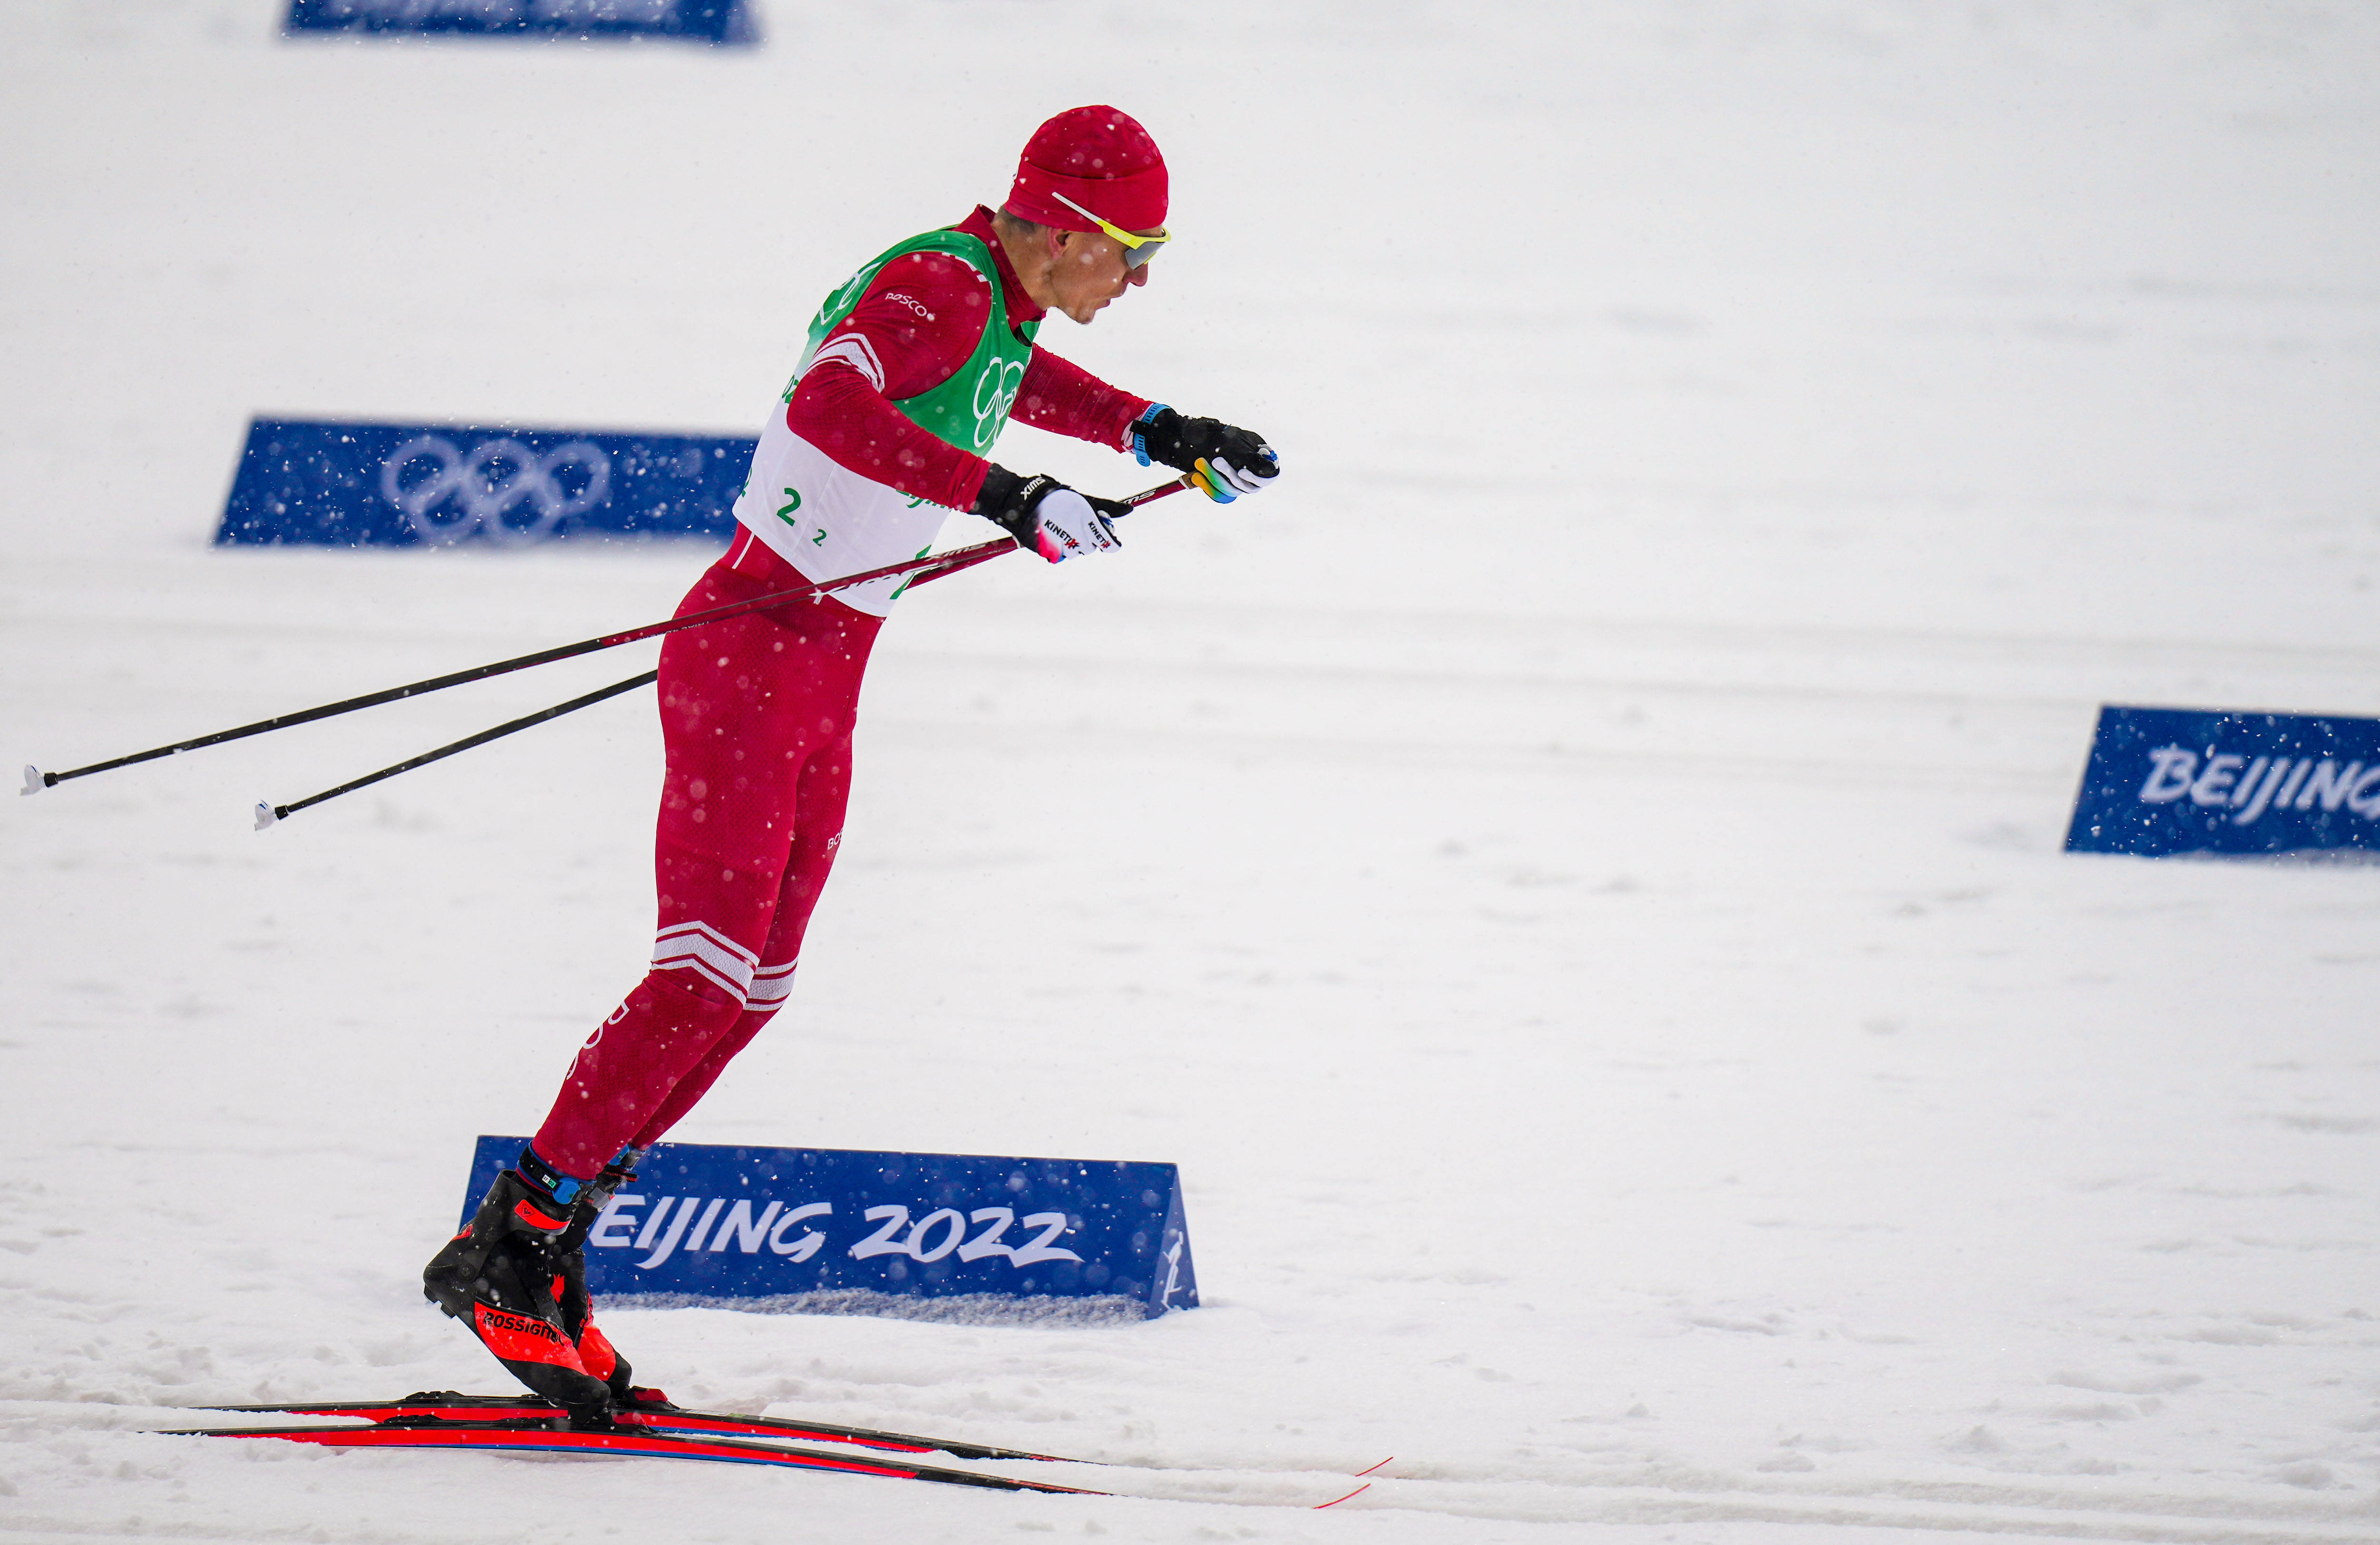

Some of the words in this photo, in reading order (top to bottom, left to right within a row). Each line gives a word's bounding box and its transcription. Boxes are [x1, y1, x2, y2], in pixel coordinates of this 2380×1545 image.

[776, 487, 801, 527] 2
[813, 529, 827, 547] 2
[588, 1194, 833, 1269] EIJING
[851, 1204, 1085, 1268] 2022
